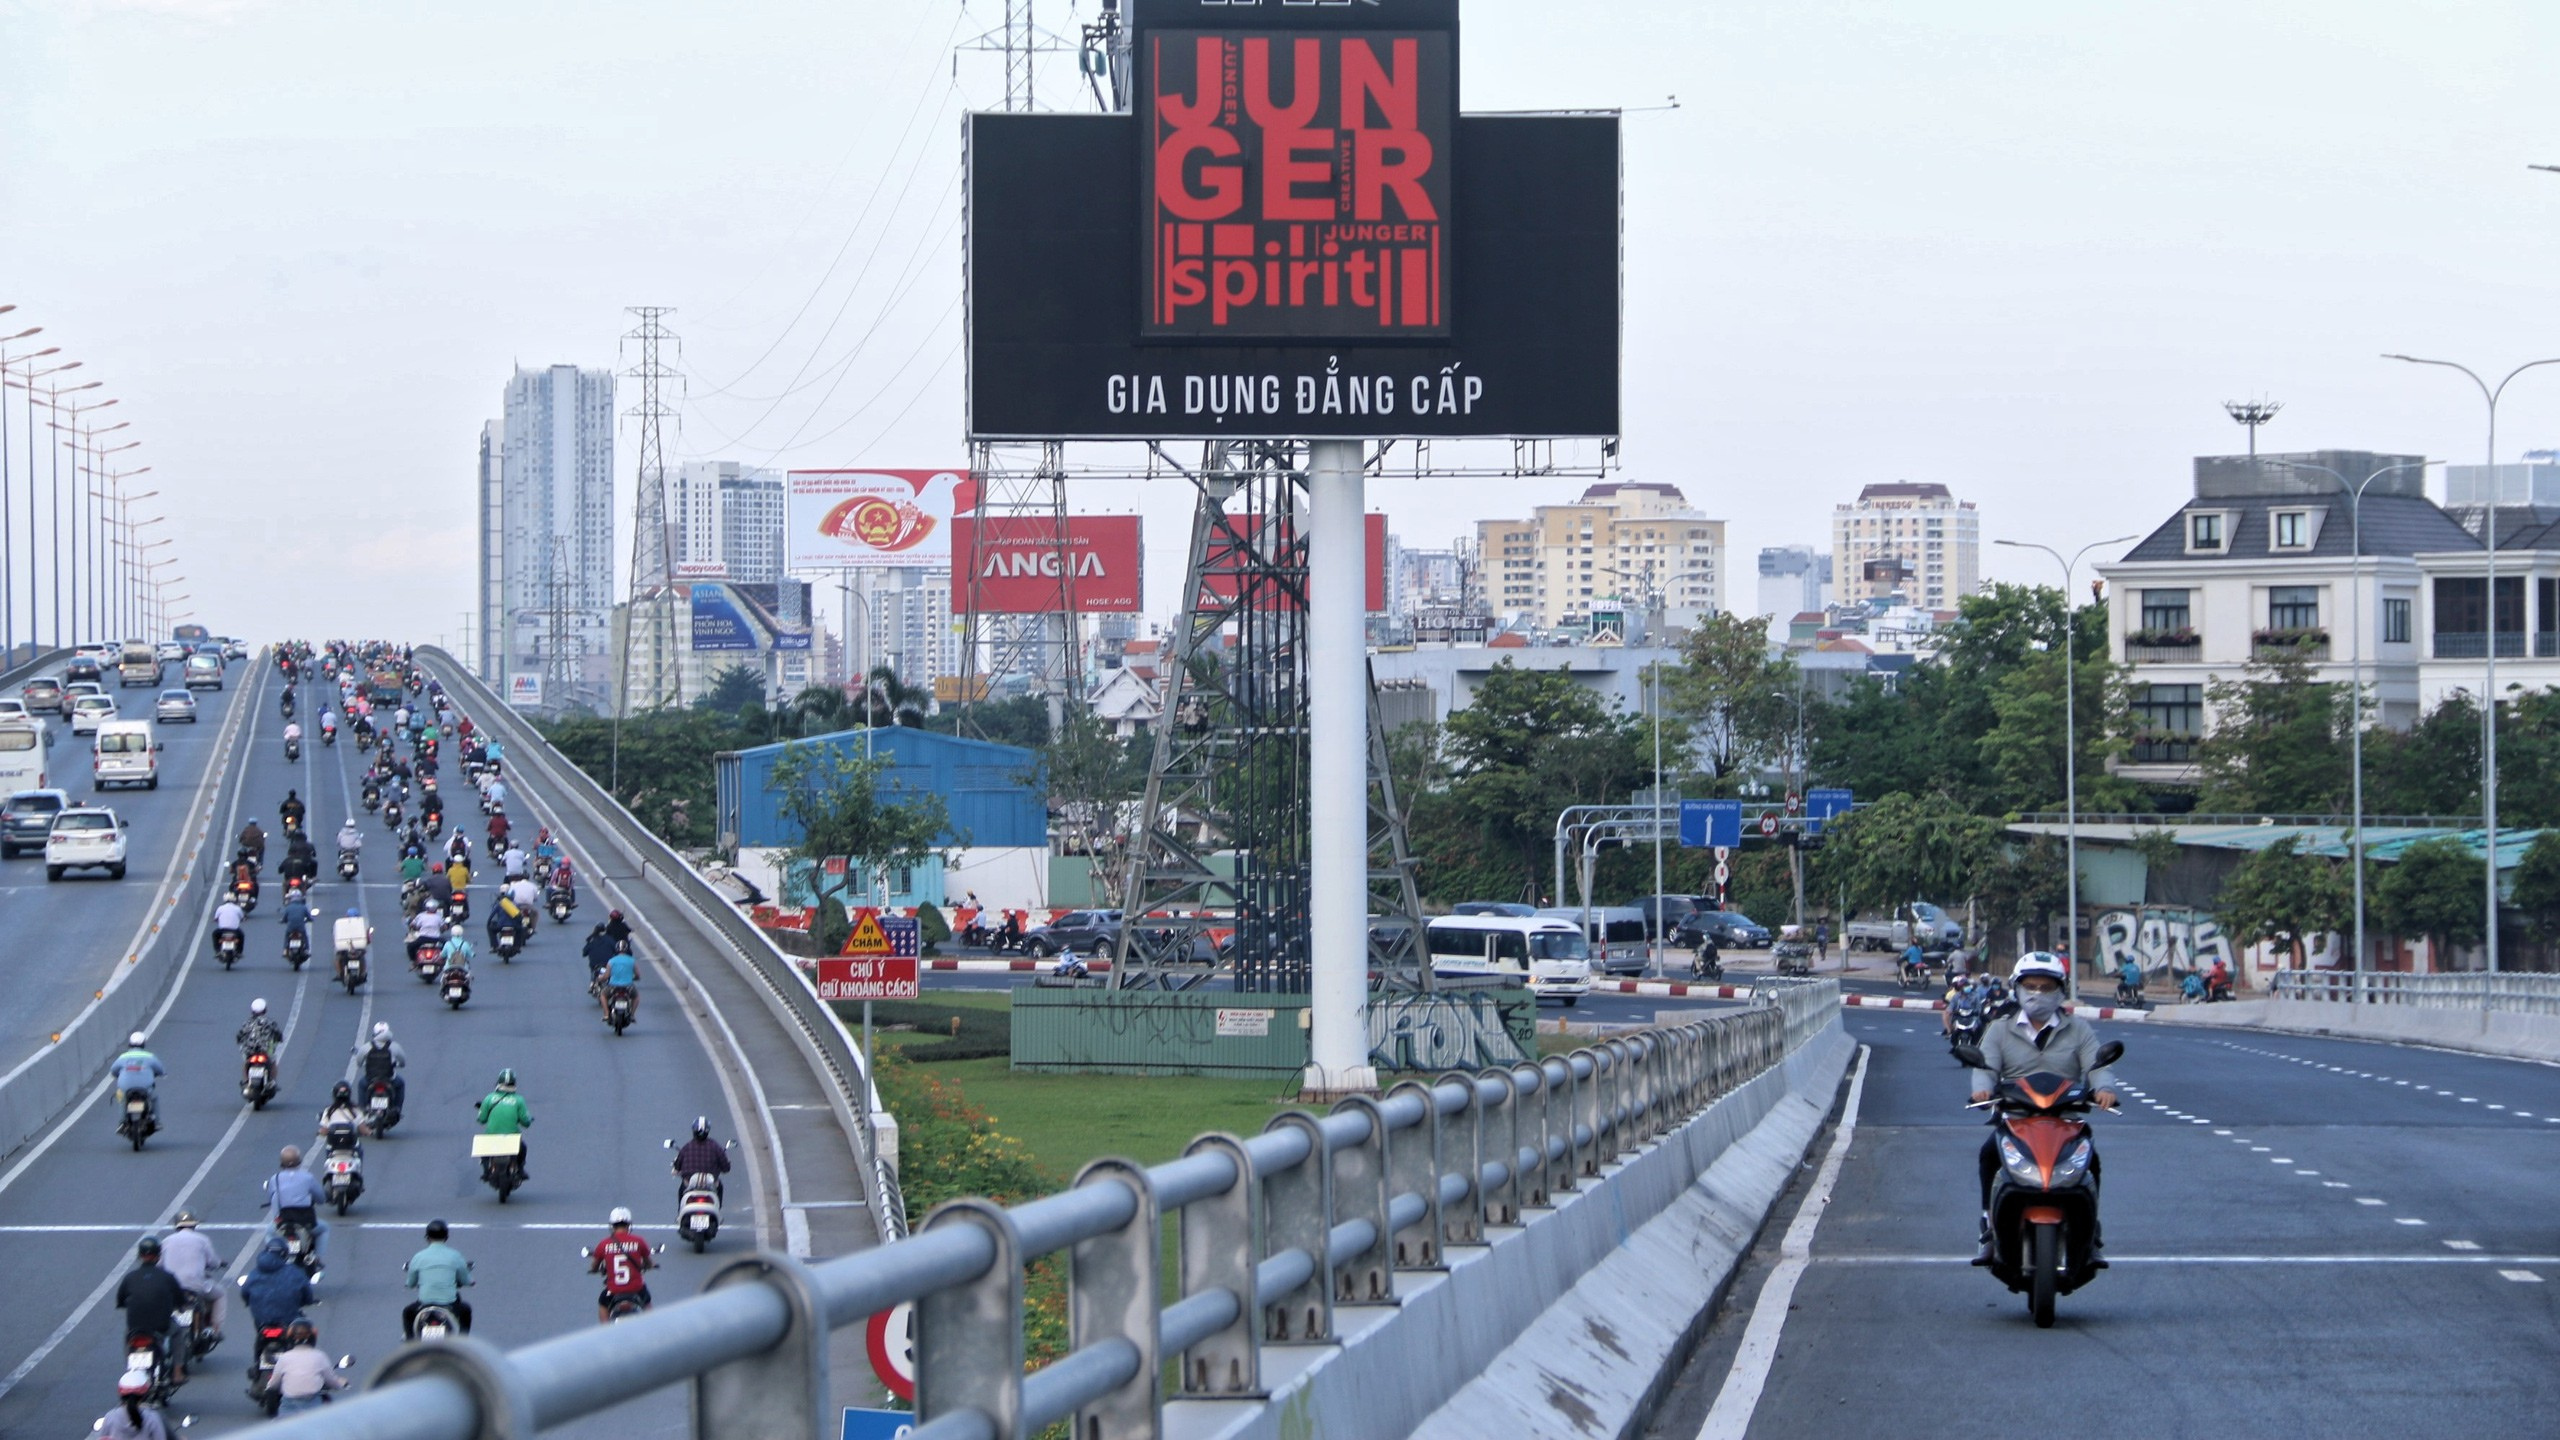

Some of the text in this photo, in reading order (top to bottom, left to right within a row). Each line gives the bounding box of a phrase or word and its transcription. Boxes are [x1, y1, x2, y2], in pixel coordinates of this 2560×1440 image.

[1223, 40, 1237, 127] JUNGER
[1340, 138, 1352, 214] CREATIVE
[1323, 224, 1428, 243] JUNGER
[1171, 241, 1375, 326] spirit
[1107, 355, 1484, 424] GIA DỤNG ĐẲNG CẤP
[677, 563, 725, 573] happycook
[1417, 616, 1486, 629] HOTEL
[863, 925, 874, 934] ĐI
[852, 937, 883, 950] CHẬM
[850, 958, 886, 978] CHÚ Ý
[820, 977, 915, 997] GIỮ KHOẢNG CÁCH
[613, 1254, 630, 1286] 5
